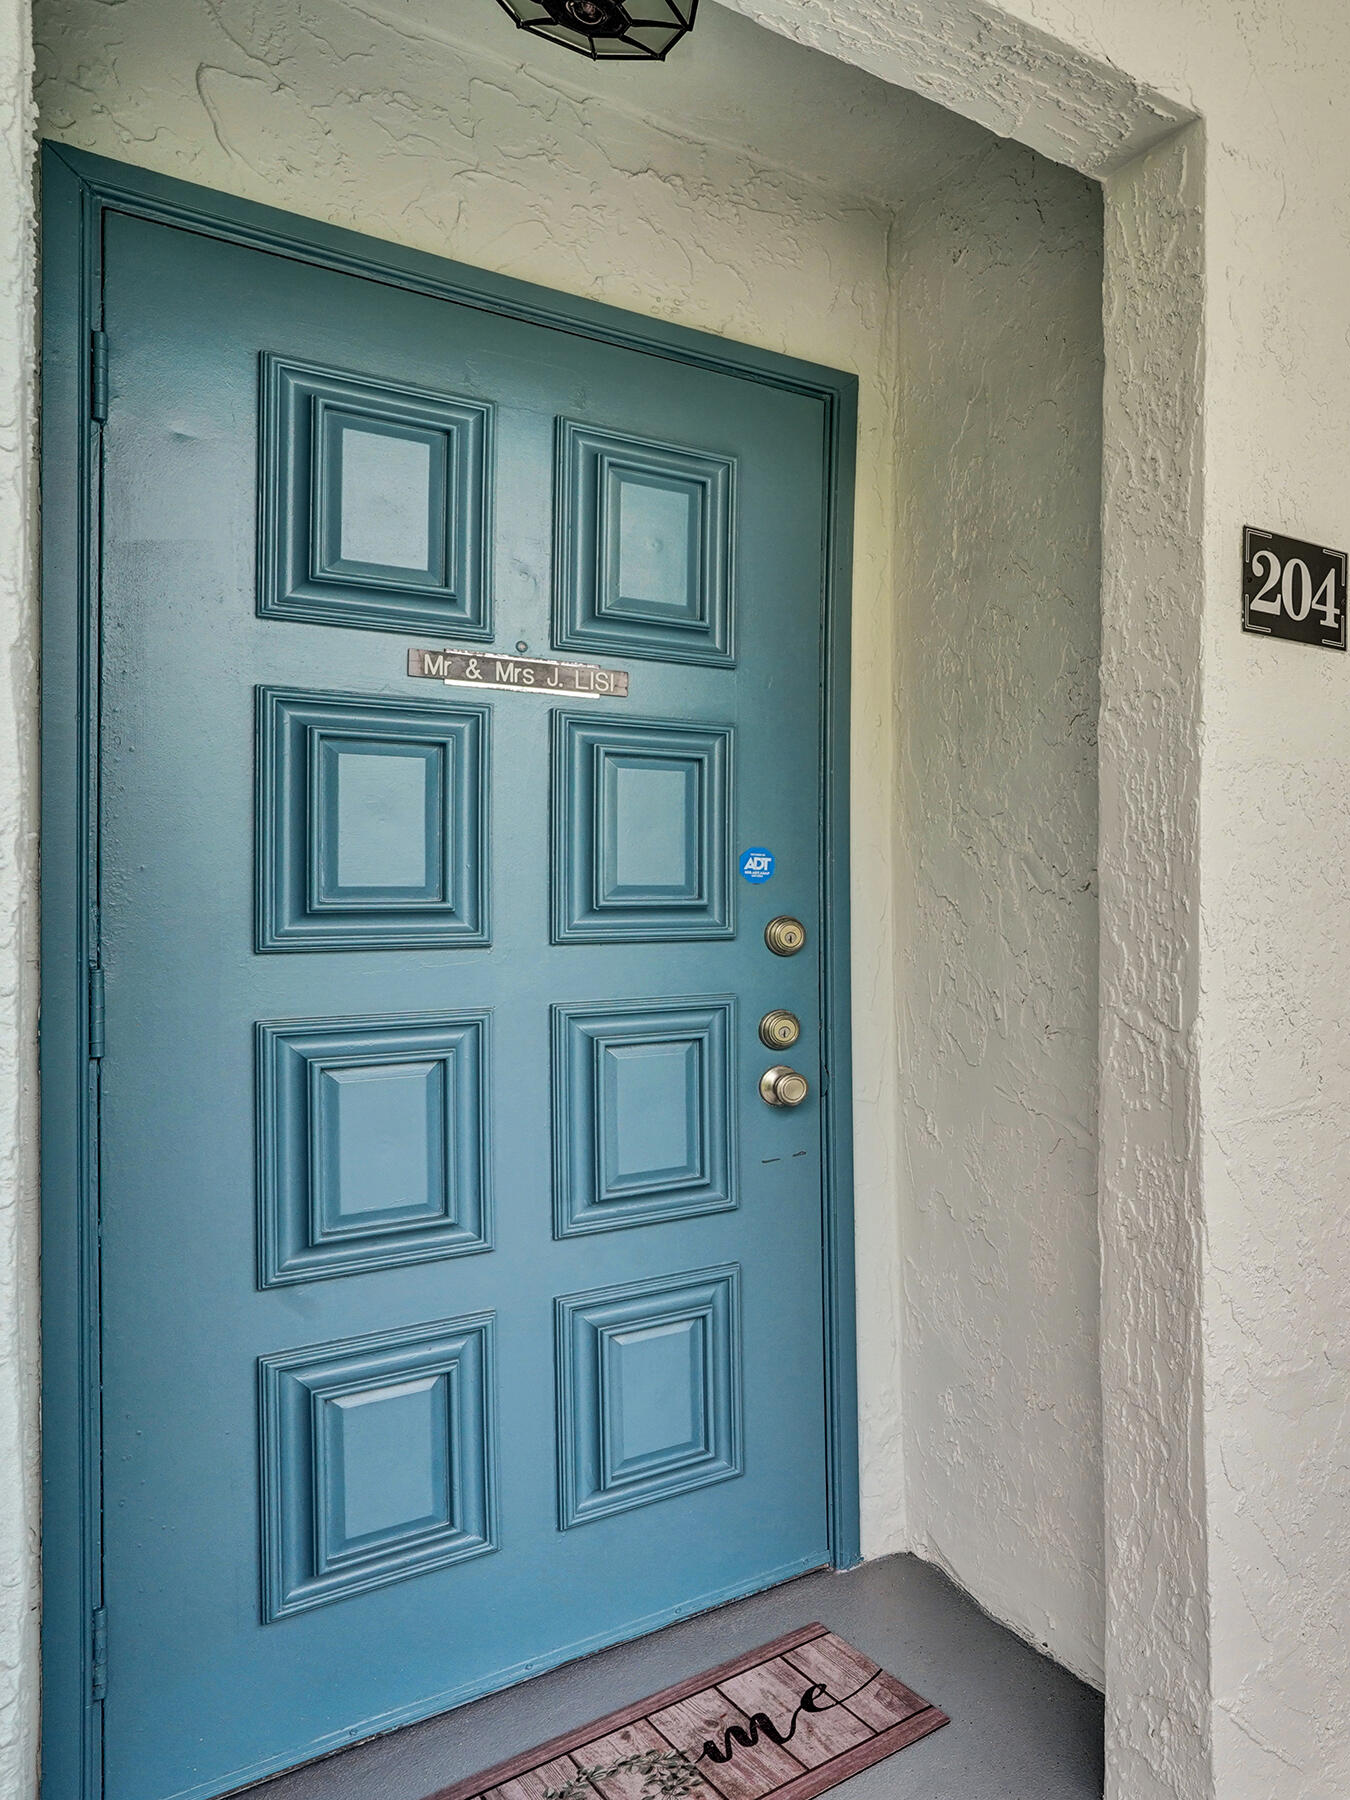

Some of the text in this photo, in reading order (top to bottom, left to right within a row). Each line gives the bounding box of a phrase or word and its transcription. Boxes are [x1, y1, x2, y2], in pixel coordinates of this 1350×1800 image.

[1250, 549, 1341, 629] 204
[423, 653, 615, 693] Mr & Mrs J. LISI
[743, 856, 772, 871] ADT
